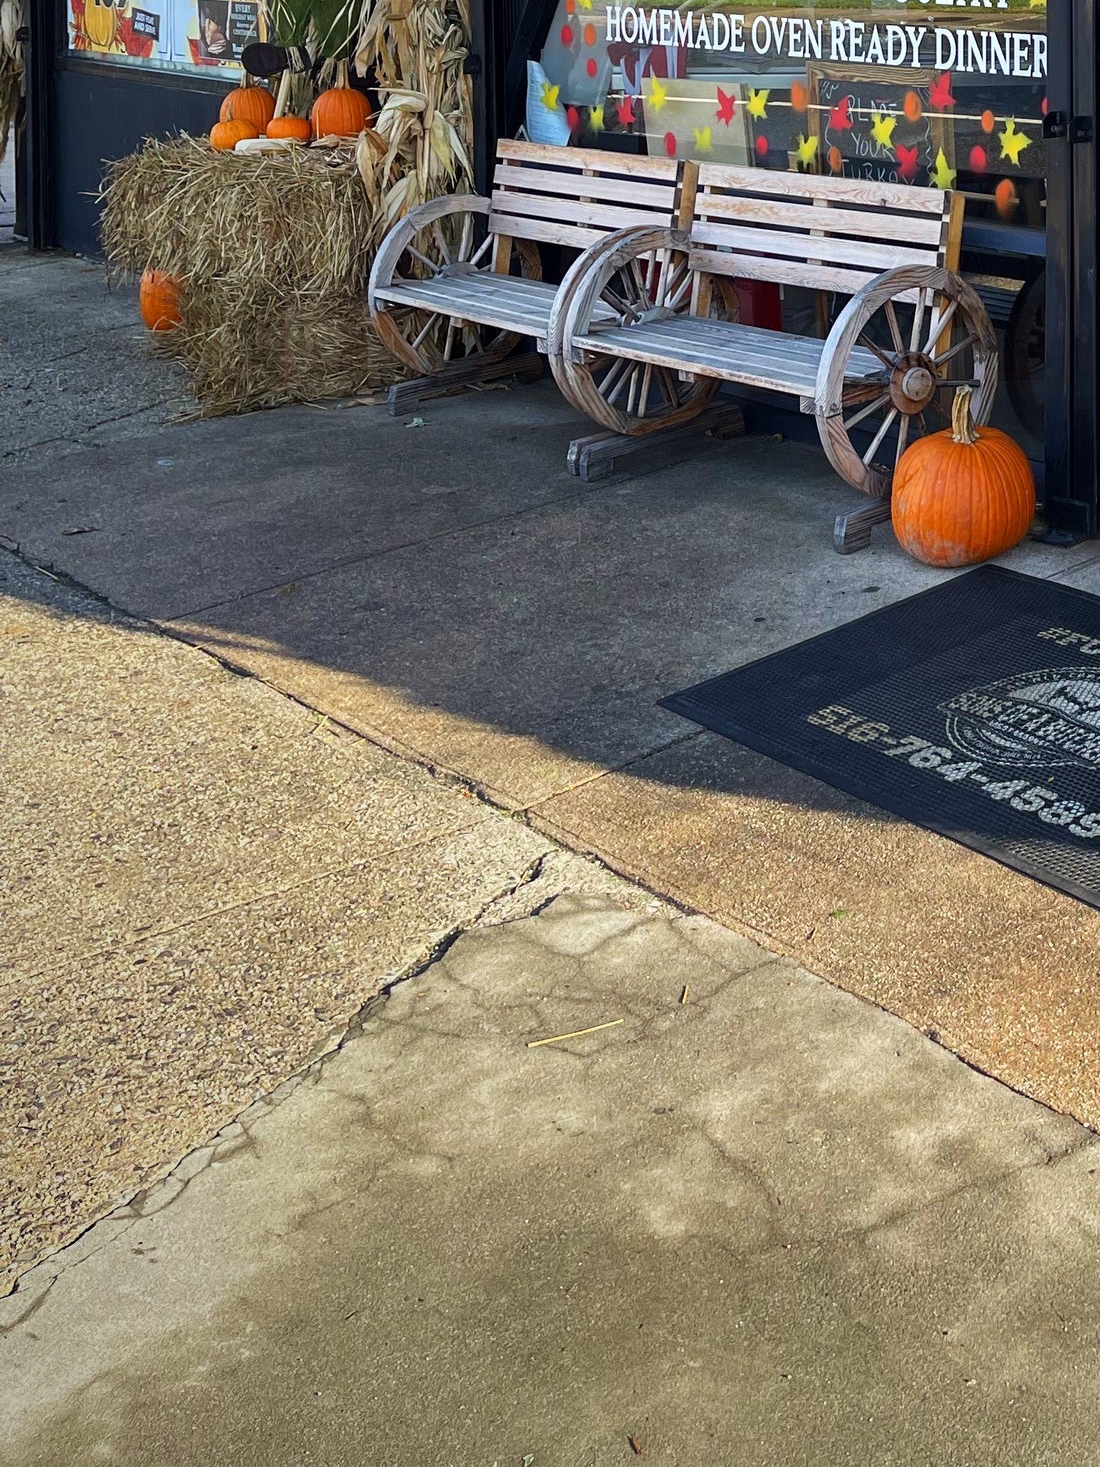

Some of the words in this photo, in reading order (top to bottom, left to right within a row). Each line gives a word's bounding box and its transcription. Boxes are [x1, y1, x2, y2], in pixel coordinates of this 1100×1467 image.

[605, 5, 745, 54] HOMEMADE
[752, 16, 823, 59] OVEN
[829, 20, 927, 69] READY
